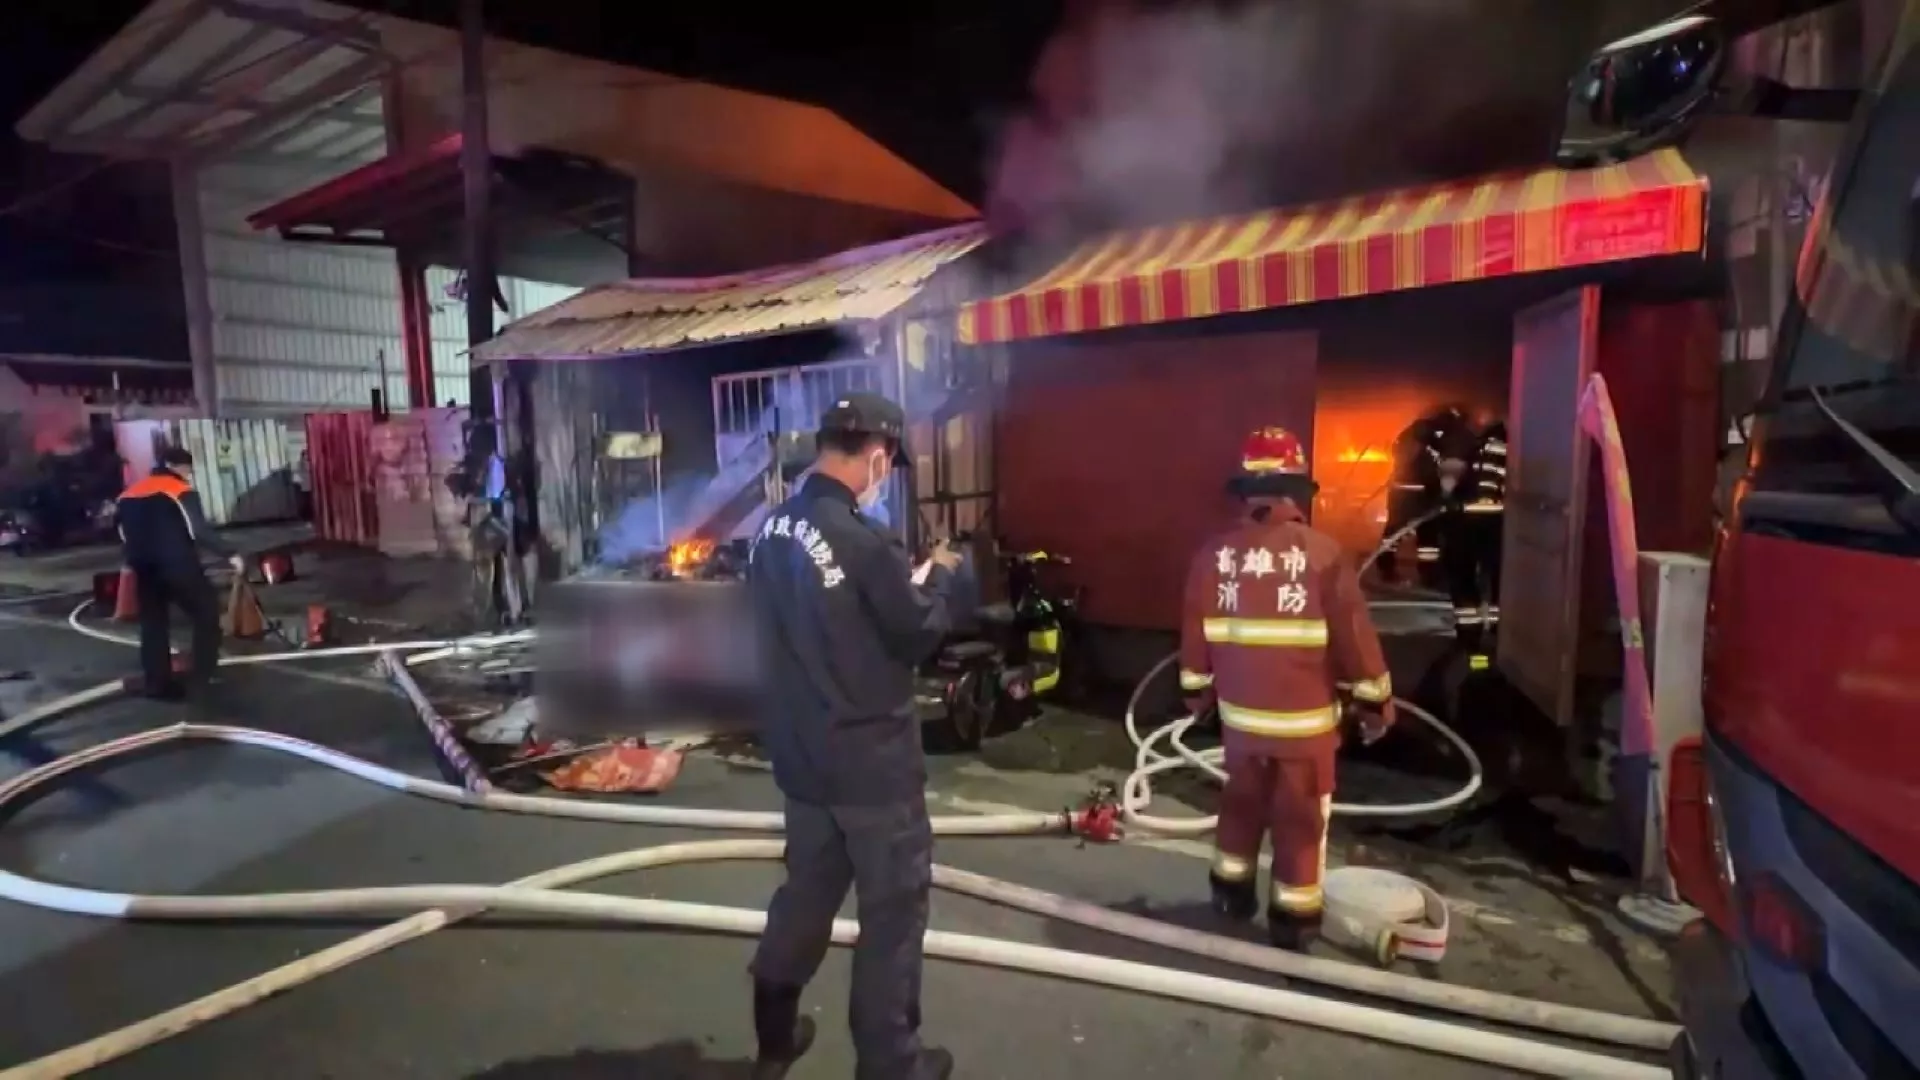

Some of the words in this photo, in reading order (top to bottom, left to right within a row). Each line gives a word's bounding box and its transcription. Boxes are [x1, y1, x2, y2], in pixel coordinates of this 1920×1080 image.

[1216, 545, 1306, 581] 高雄市
[1217, 582, 1307, 614] 消防
